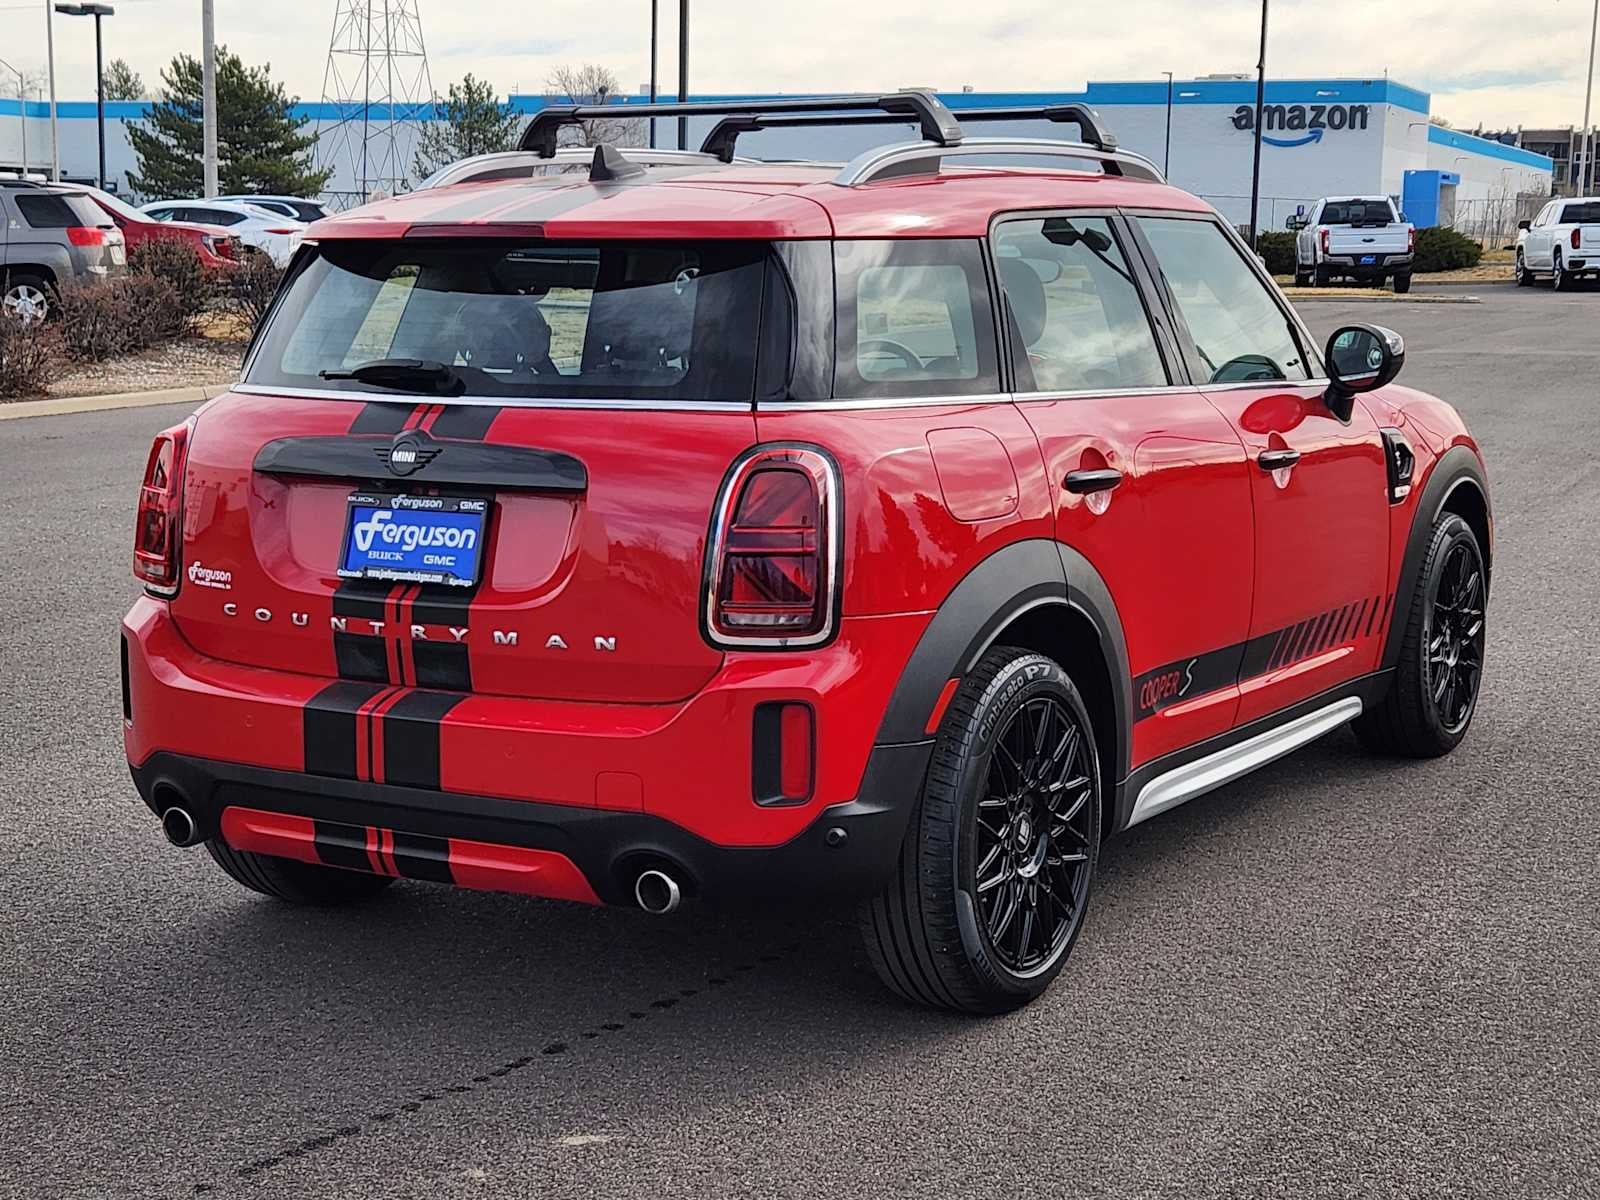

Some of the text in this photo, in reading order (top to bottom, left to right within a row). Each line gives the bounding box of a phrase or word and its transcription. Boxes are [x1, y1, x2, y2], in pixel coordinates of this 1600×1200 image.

[1233, 104, 1368, 130] amazon
[392, 450, 416, 463] MINI
[391, 494, 443, 509] Ferguson
[460, 500, 485, 510] GMC
[354, 510, 476, 551] Ferguson
[367, 550, 456, 566] BUICK GMC
[188, 561, 232, 582] Ferguson
[222, 602, 617, 651] COUNTRYMAN
[1024, 663, 1051, 681] P7
[1139, 658, 1198, 710] COOPER S
